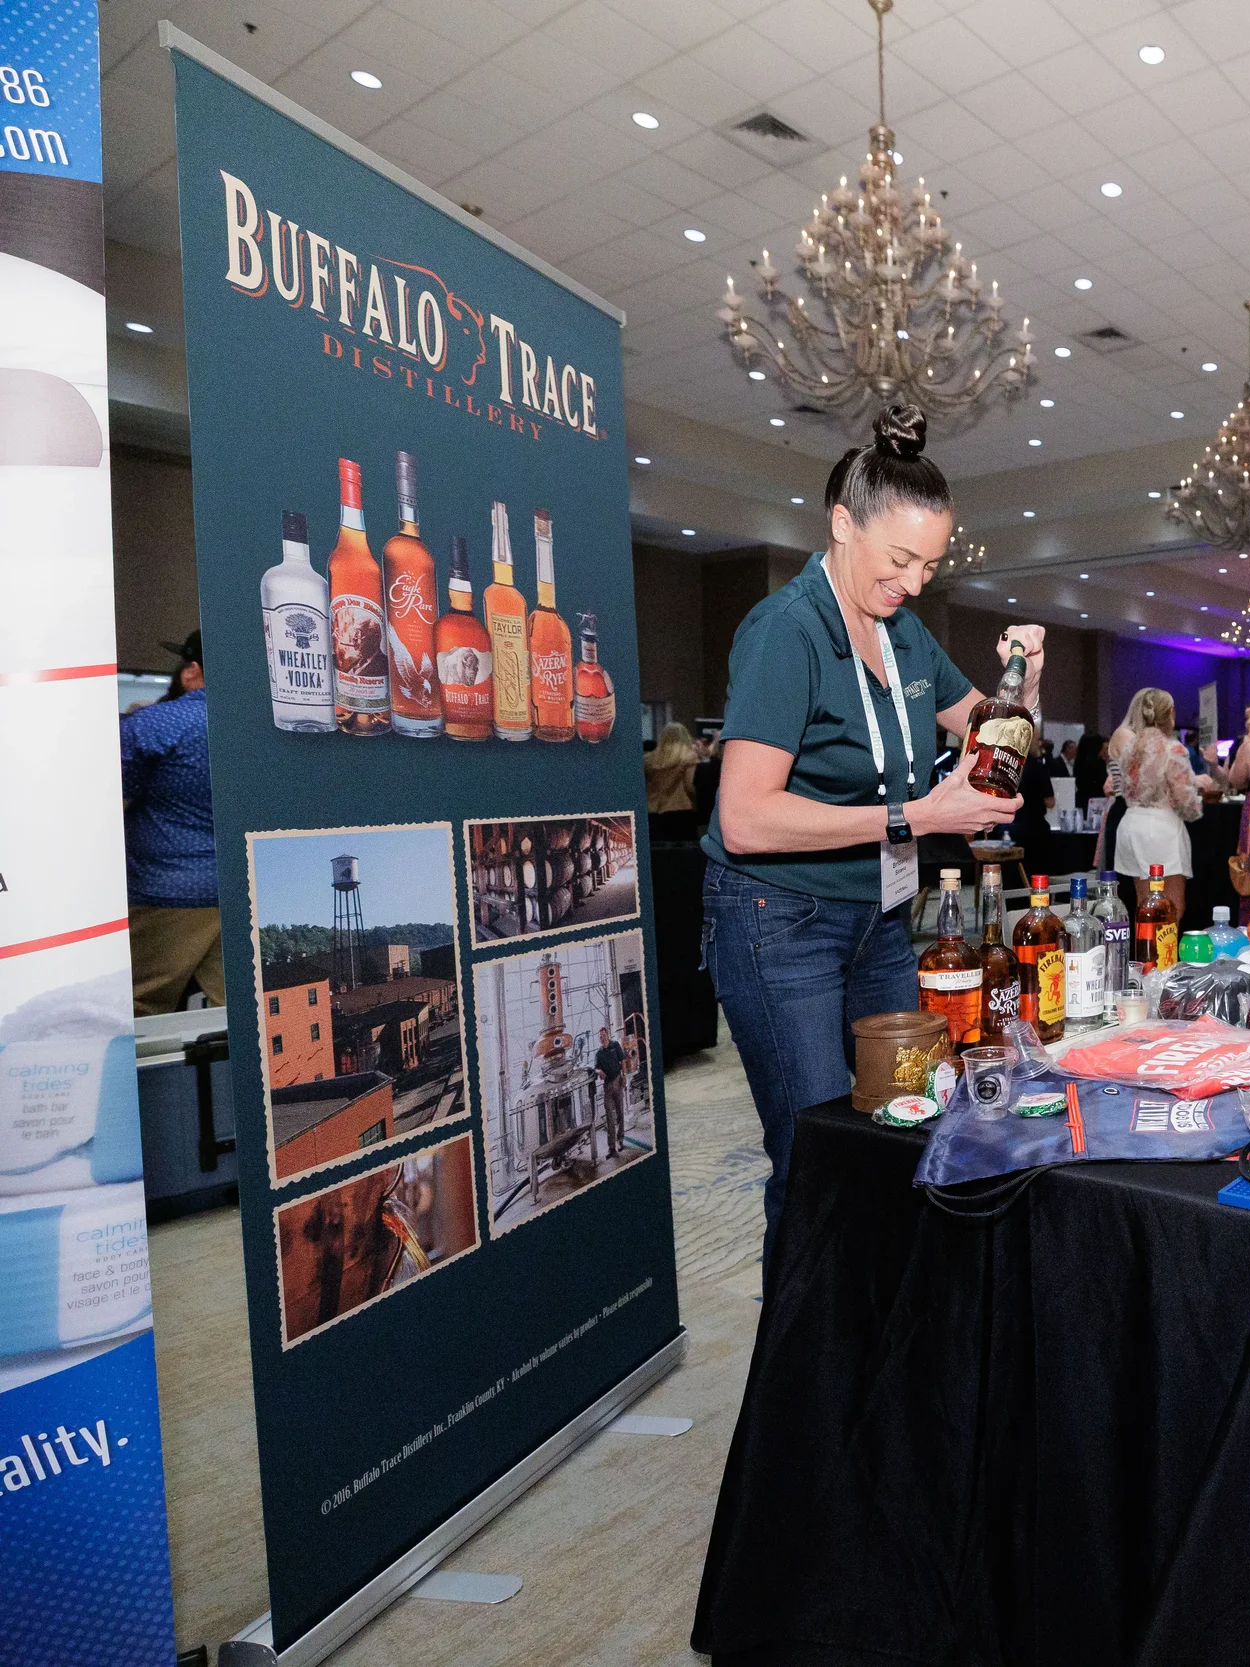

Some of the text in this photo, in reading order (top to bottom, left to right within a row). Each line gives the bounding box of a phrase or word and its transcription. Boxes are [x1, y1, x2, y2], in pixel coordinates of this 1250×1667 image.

[219, 168, 599, 440] BUFFALO TRACE
[321, 332, 543, 441] DISTILLERY
[493, 621, 522, 635] TAYLOR
[279, 650, 327, 671] WHEATLEY
[883, 641, 895, 669] Littler
[287, 669, 323, 689] VODKA
[891, 682, 905, 710] Littler
[993, 747, 1019, 770] BUFFALO
[8, 1062, 91, 1079] calming
[22, 1078, 73, 1092] tides
[22, 1102, 69, 1115] bath bar
[95, 1234, 148, 1255] tides
[73, 1257, 149, 1283] face & body
[67, 1293, 109, 1310] visage
[113, 1288, 125, 1300] et
[130, 1284, 140, 1296] le
[81, 1279, 119, 1295] savon
[332, 1485, 353, 1509] 2016,
[353, 1466, 381, 1495] Buffalo
[380, 1452, 402, 1474] Trace
[402, 1429, 434, 1460] Distillery
[447, 1400, 475, 1428] Franklin
[495, 1376, 505, 1394] KY
[511, 1359, 533, 1383] Alcohol
[532, 1356, 539, 1369] by
[0, 1420, 128, 1497] ality.
